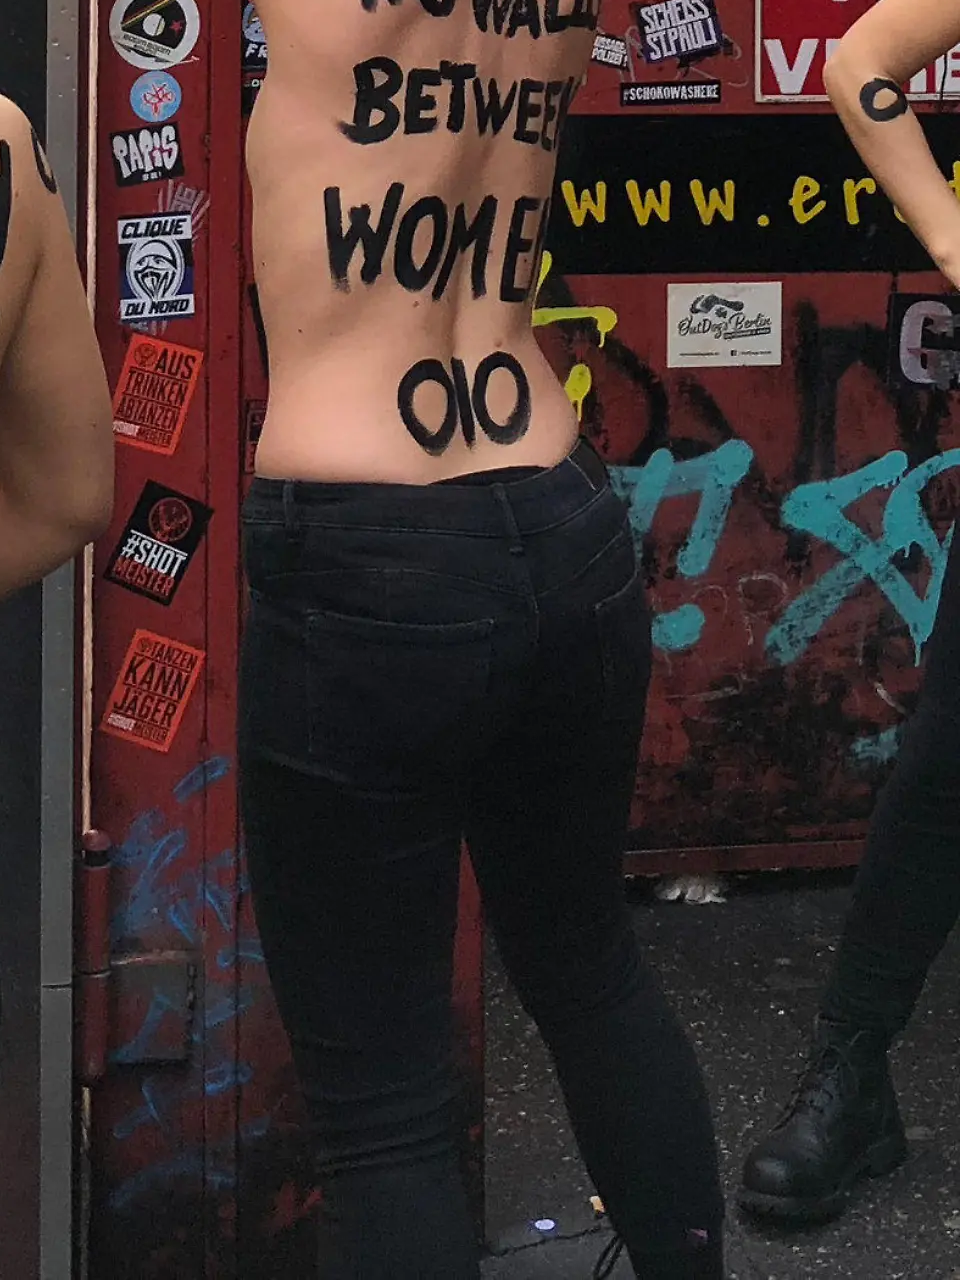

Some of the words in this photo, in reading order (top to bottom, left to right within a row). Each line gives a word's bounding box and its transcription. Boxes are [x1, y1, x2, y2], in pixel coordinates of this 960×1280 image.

[623, 83, 720, 101] #SCHOKOWASHERE
[121, 217, 188, 240] CLIQUE
[124, 301, 146, 316] DU
[148, 297, 190, 315] NORD
[729, 312, 772, 330] Berlin
[154, 347, 196, 380] AUS
[125, 370, 189, 406] TRINKEN
[121, 533, 187, 578] #SHOT
[113, 557, 176, 597] MEISTER
[149, 640, 198, 669] TANZEN
[124, 657, 191, 700] KANN
[113, 686, 178, 728] JÄGER
